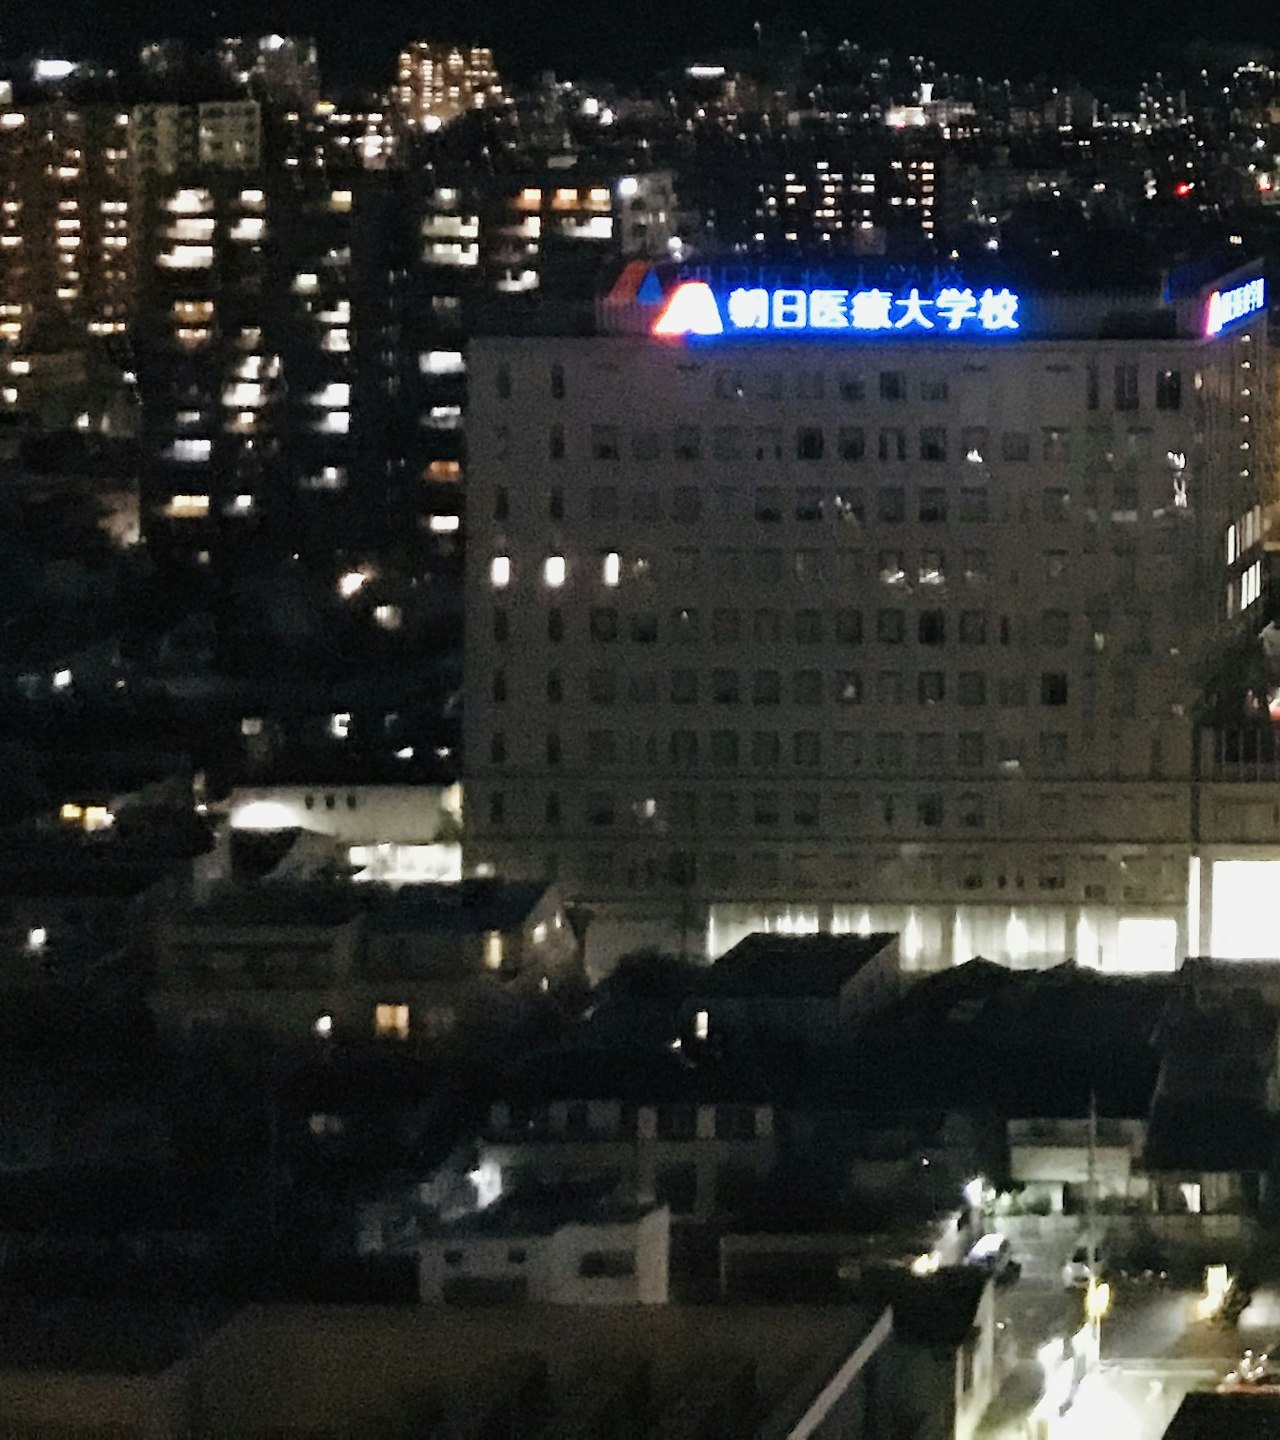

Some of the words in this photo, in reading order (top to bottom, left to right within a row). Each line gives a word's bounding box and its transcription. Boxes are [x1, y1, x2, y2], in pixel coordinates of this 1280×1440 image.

[727, 288, 1020, 329] 朝日医療大学校
